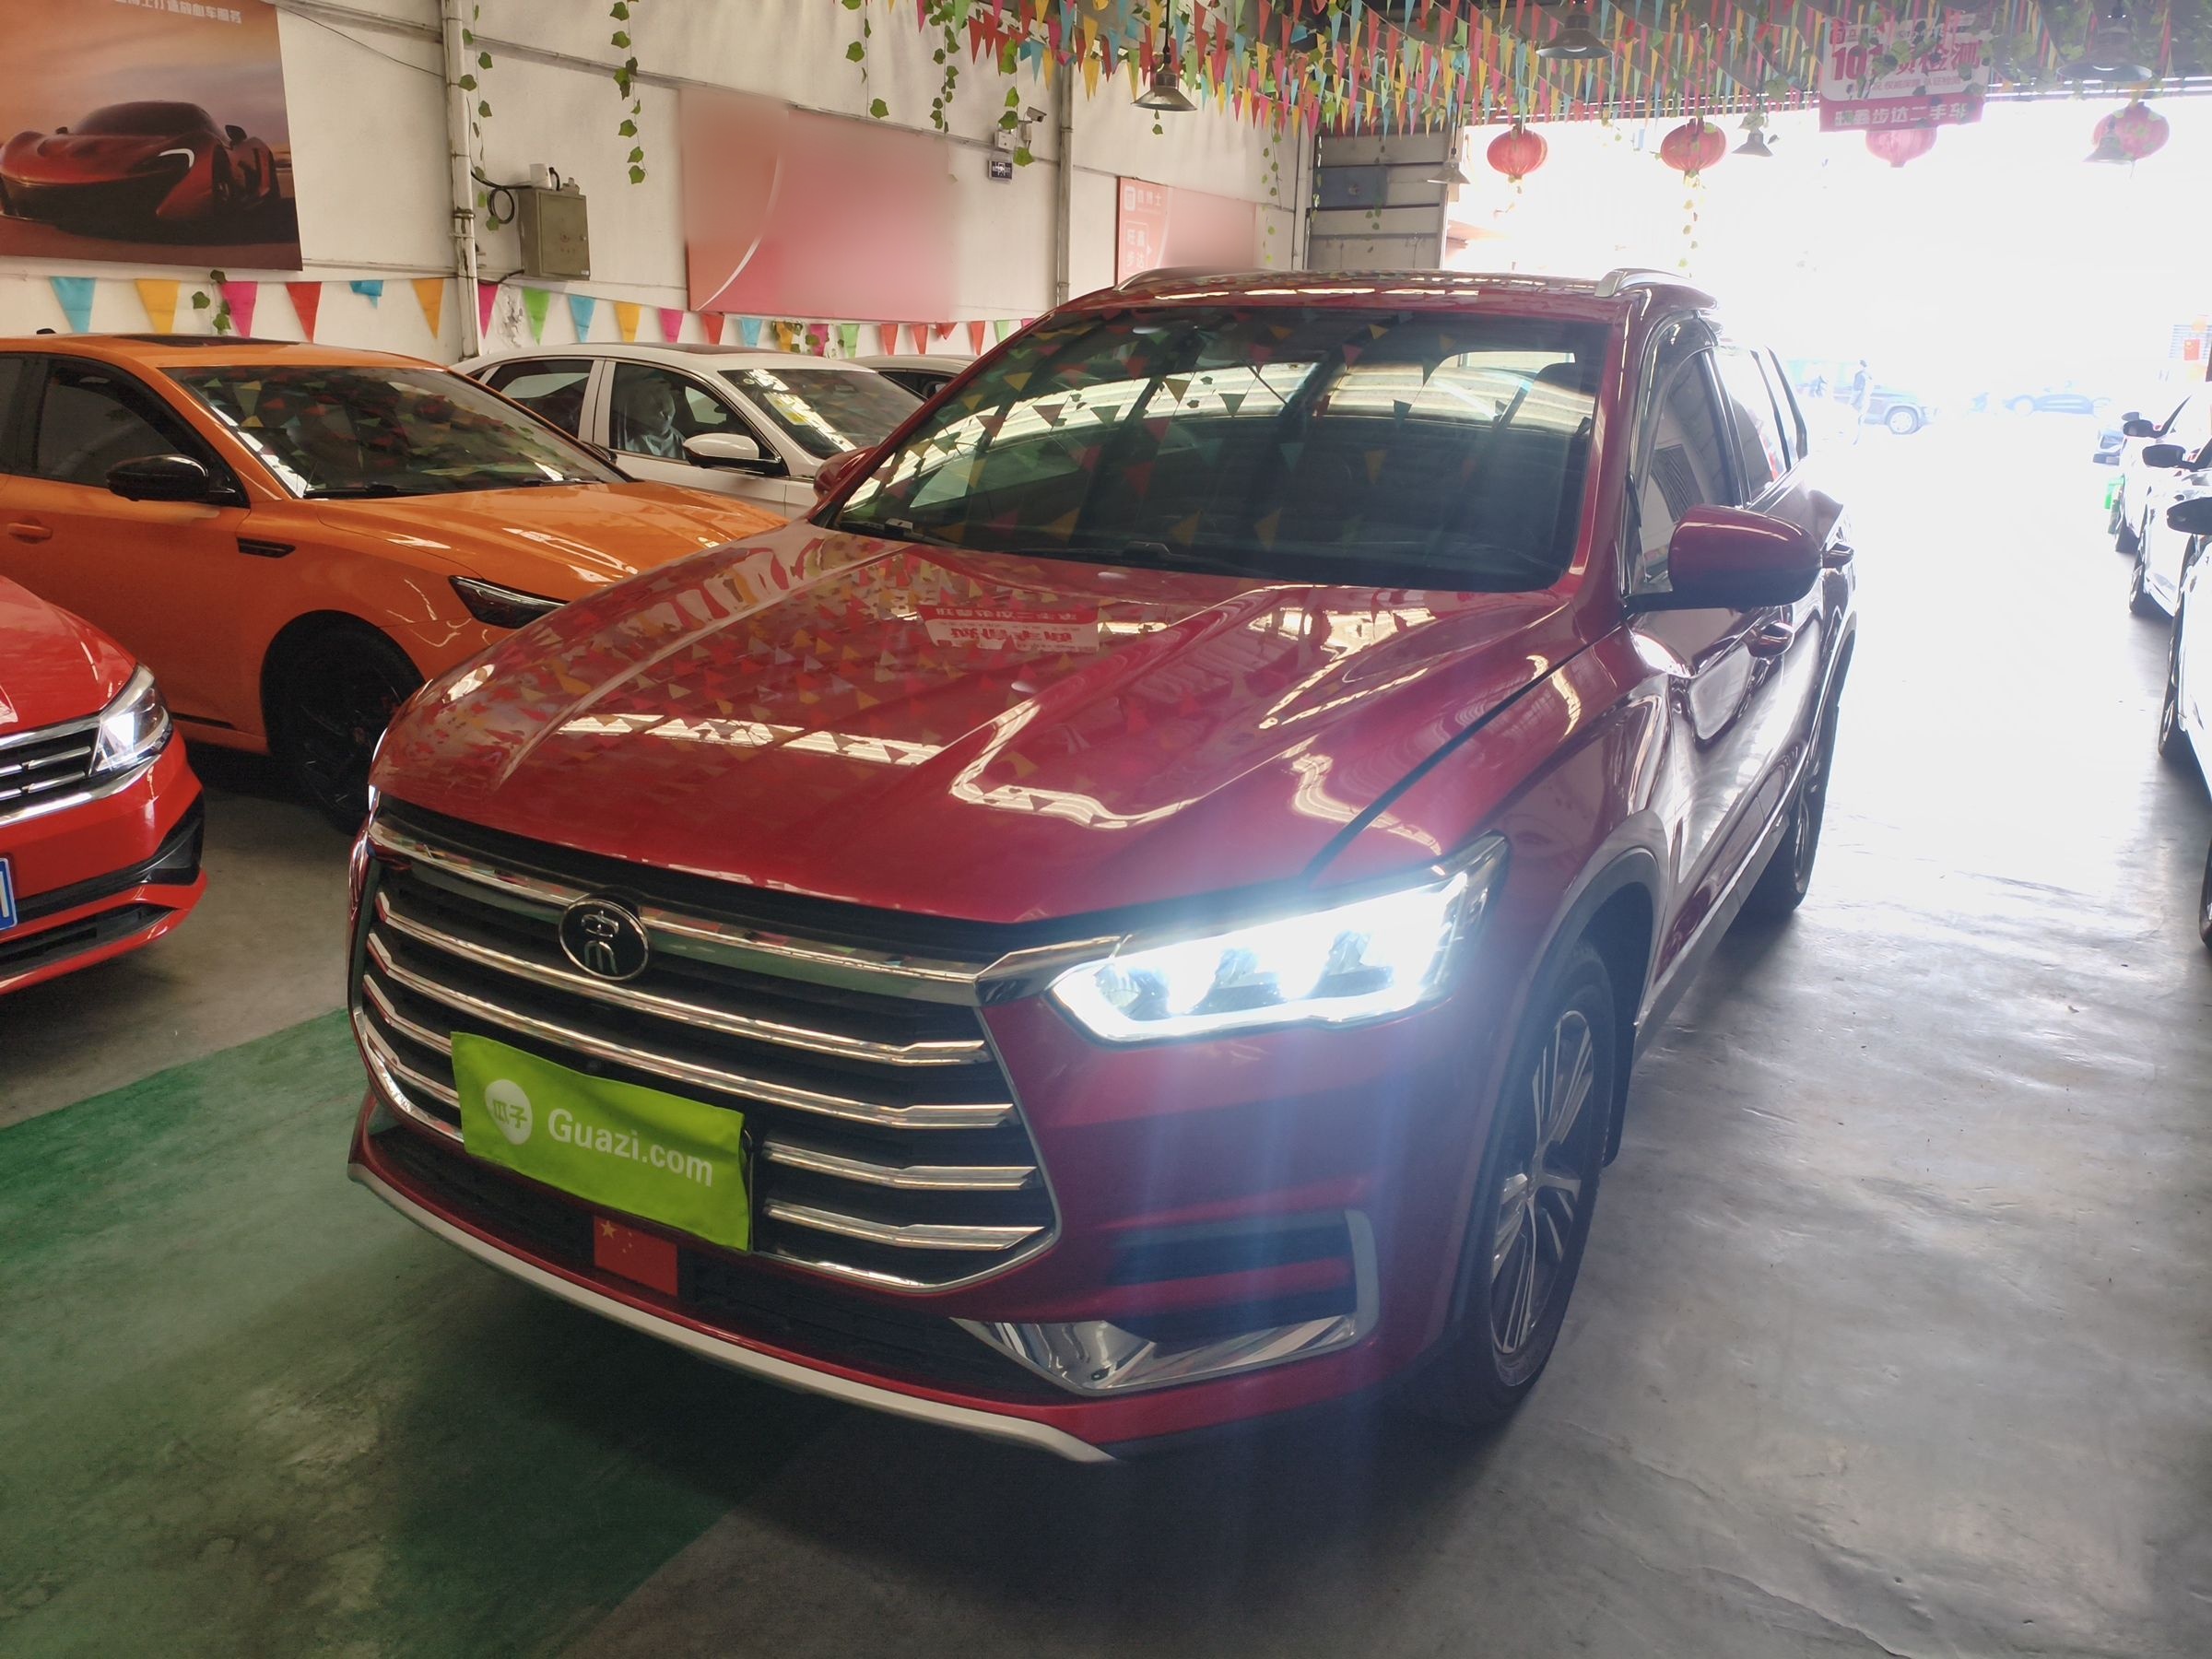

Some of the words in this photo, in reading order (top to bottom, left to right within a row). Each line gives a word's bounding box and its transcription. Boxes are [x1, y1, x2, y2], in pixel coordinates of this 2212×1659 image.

[115, 0, 241, 24] 士打造放心车服务
[492, 1100, 528, 1129] 瓜子
[547, 1108, 713, 1188] Guazi.com
